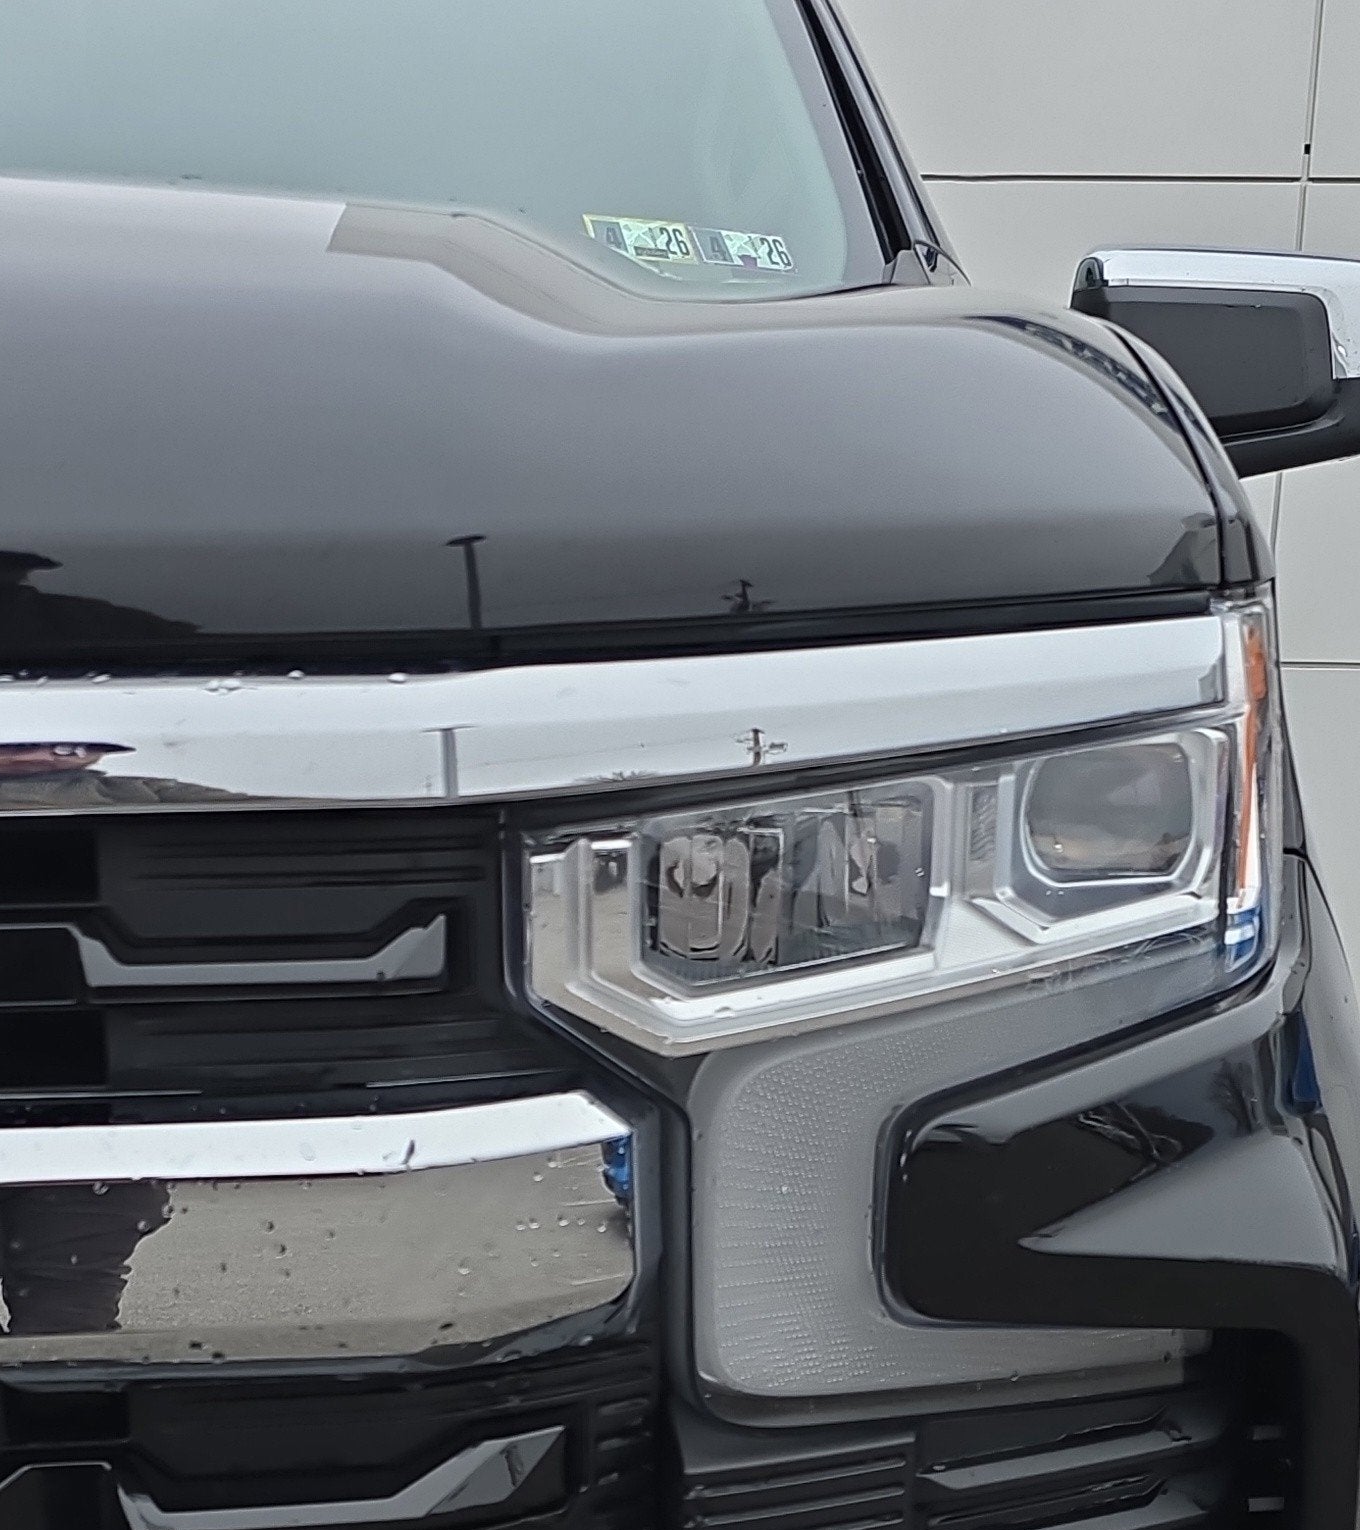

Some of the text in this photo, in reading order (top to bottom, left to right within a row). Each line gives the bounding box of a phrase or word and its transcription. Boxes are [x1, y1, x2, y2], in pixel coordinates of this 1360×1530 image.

[659, 227, 690, 255] 26
[710, 236, 727, 261] 4
[759, 237, 791, 266] 26
